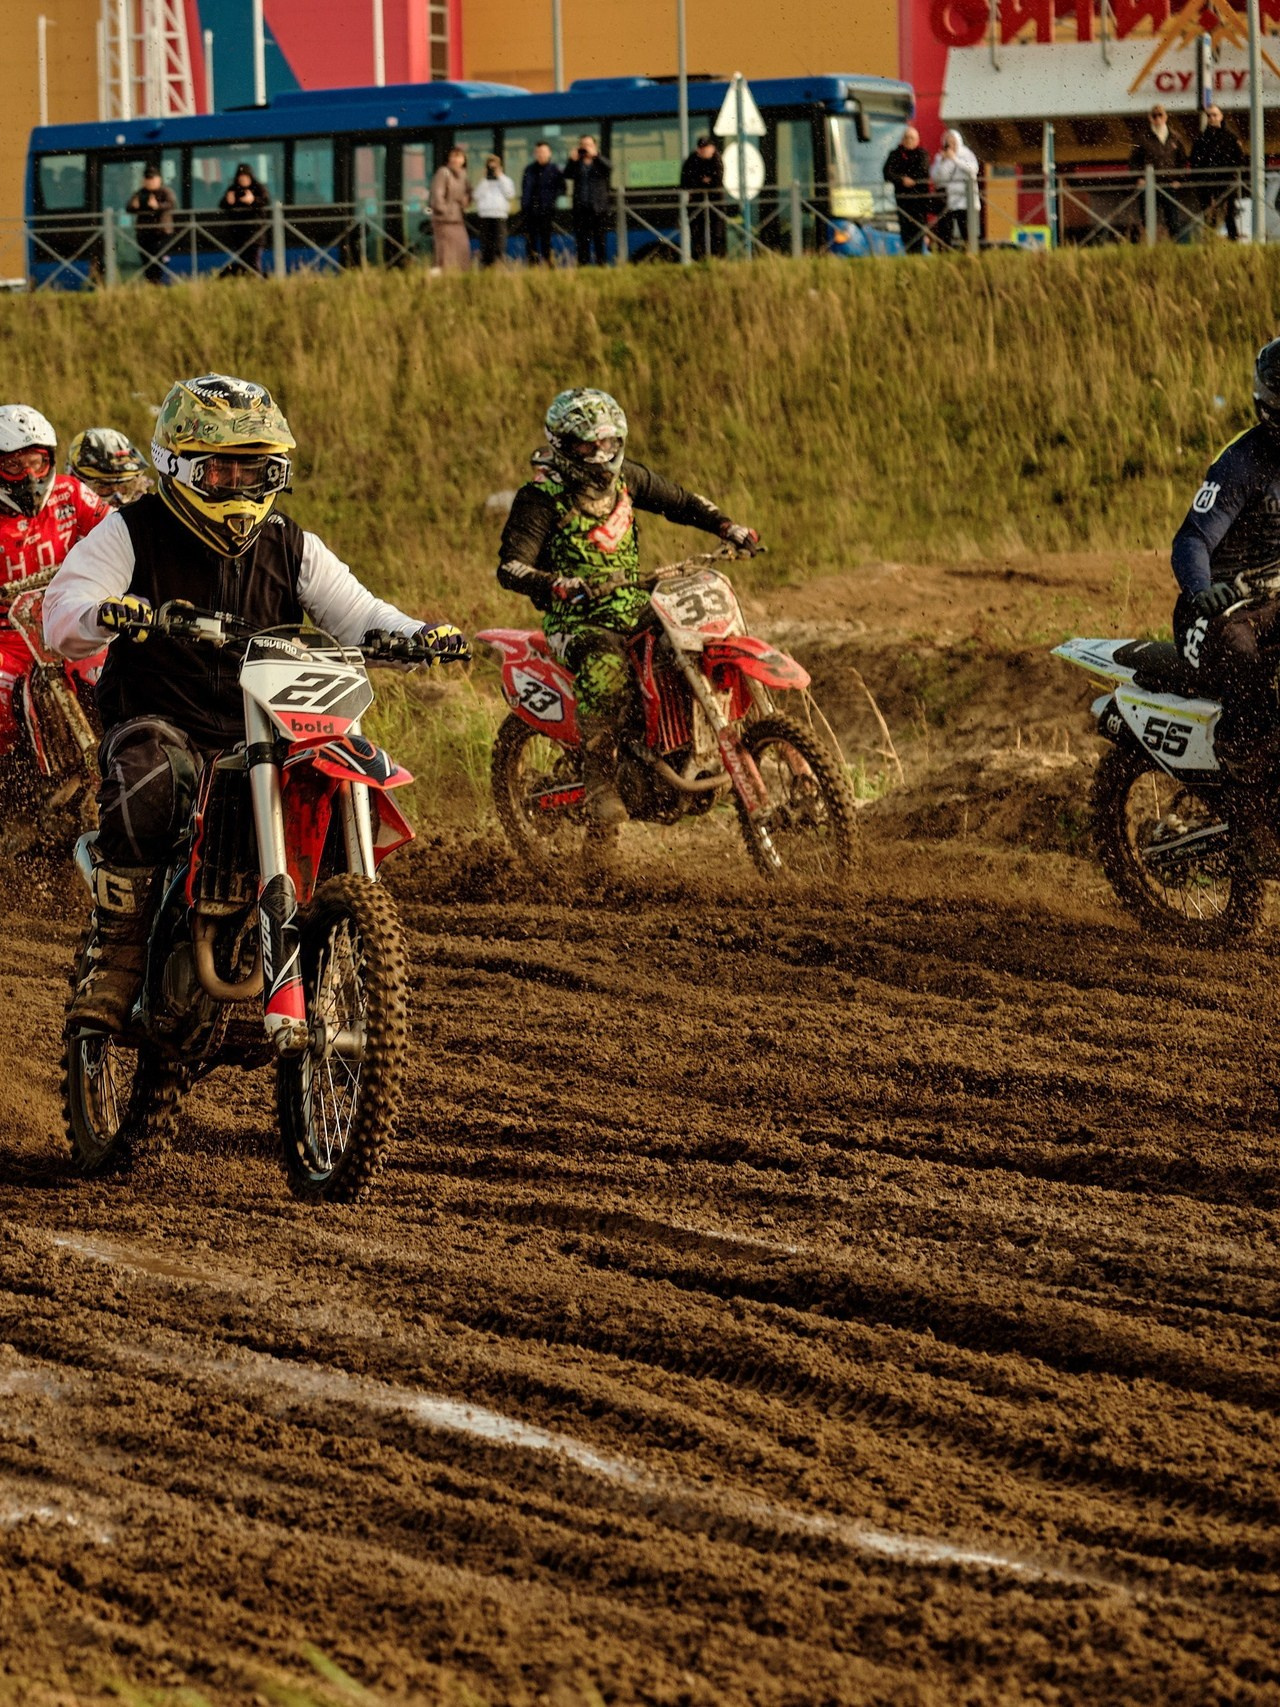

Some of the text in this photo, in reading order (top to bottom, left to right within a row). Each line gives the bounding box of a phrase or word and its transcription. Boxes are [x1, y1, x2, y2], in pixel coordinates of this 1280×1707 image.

[676, 589, 730, 626] 33
[269, 672, 360, 707] 21
[519, 681, 560, 713] 33
[291, 719, 334, 734] bold
[1142, 716, 1193, 757] 55
[260, 907, 273, 982] BOLD
